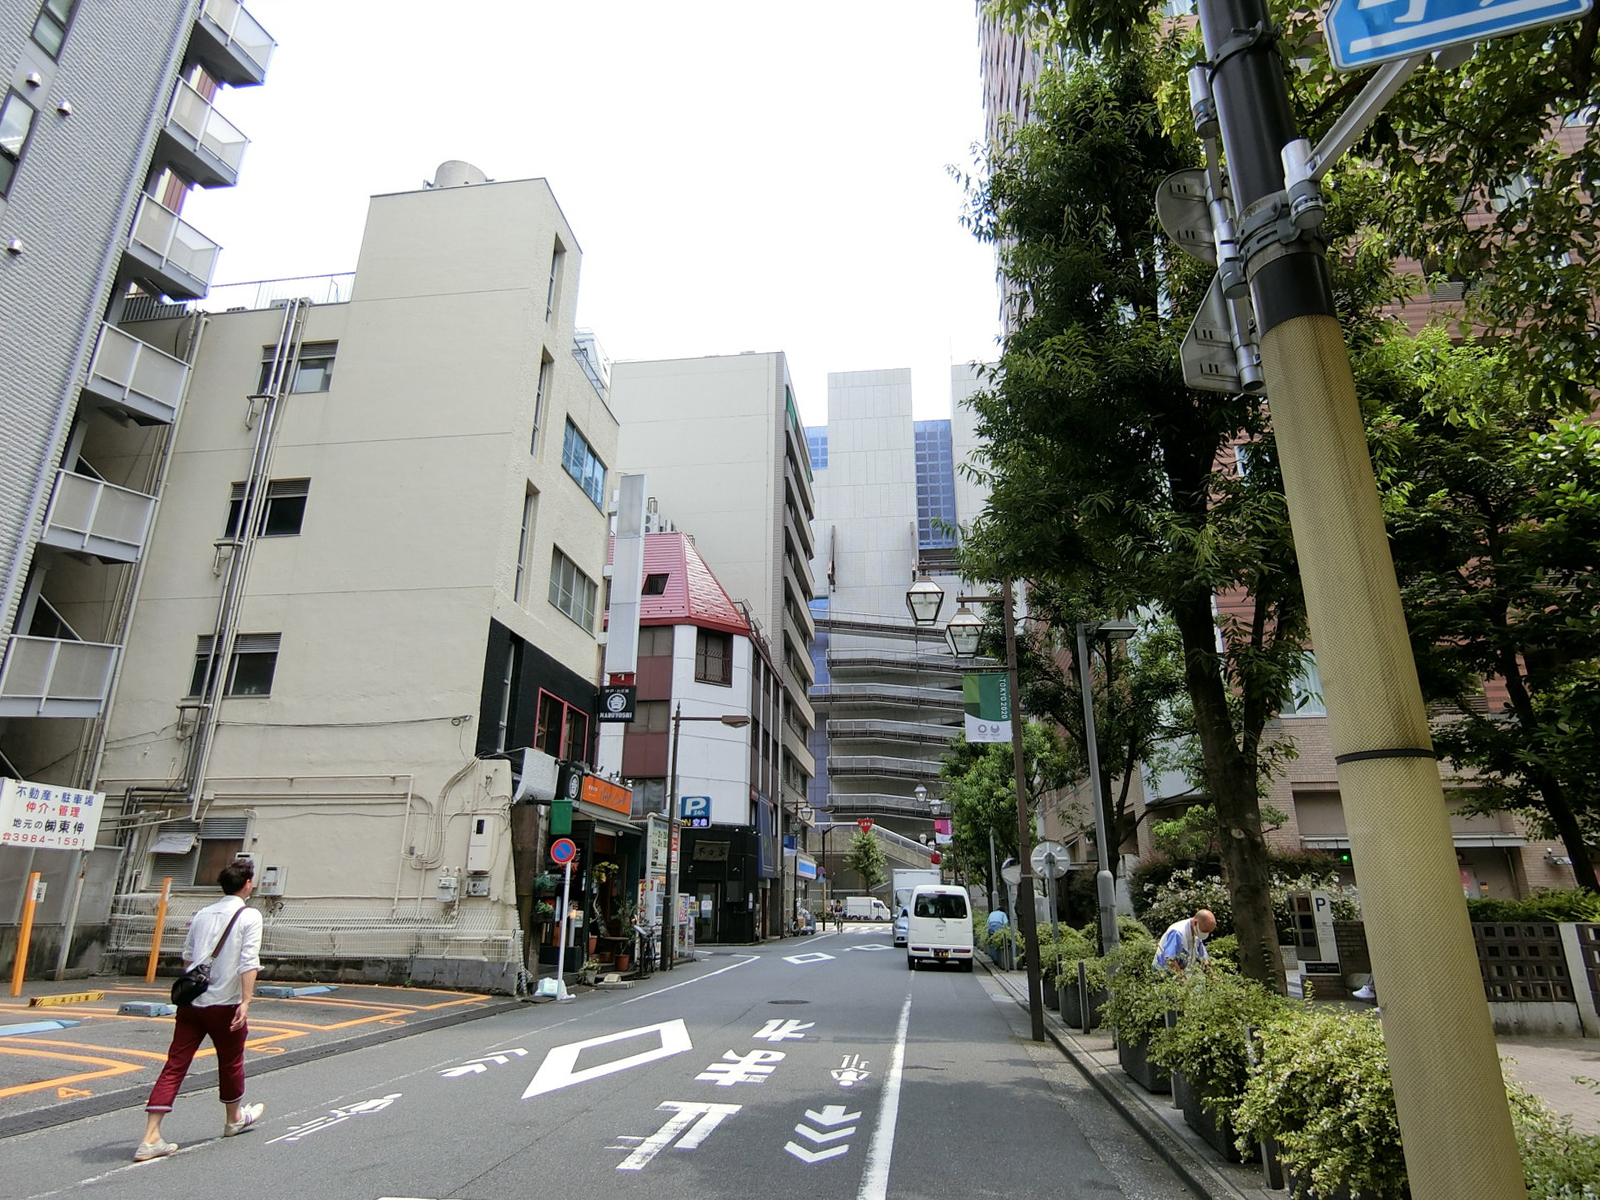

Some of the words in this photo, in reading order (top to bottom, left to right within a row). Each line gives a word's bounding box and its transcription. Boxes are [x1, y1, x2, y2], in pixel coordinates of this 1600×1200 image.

[999, 678, 1007, 701] TOKYO
[1000, 701, 1008, 719] 2020
[16, 786, 94, 806] 不動産・駐車場
[25, 801, 82, 818] 仲介・管理
[684, 797, 706, 815] P
[692, 818, 707, 827] 空車
[1314, 897, 1326, 912] P
